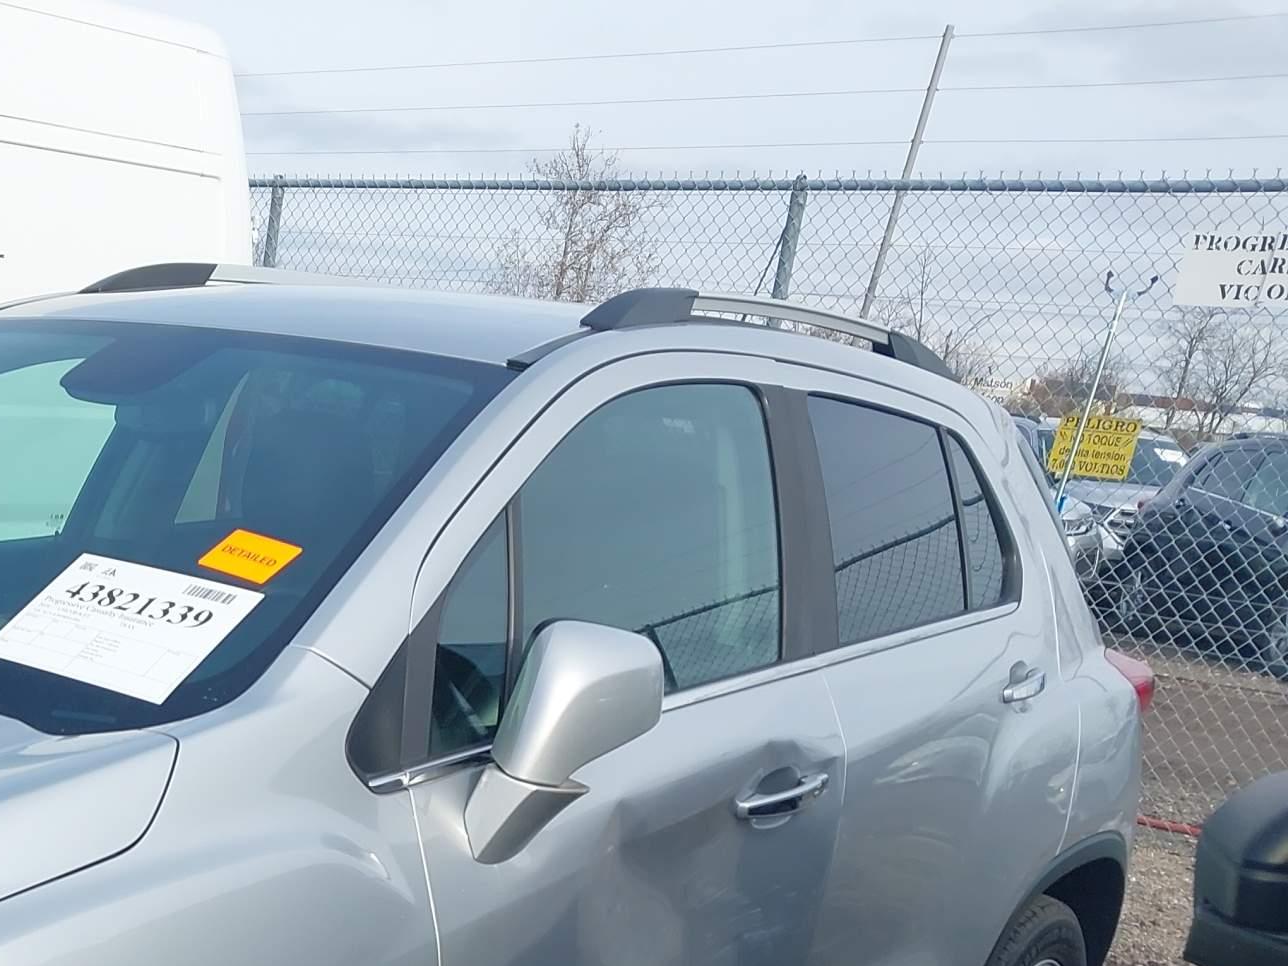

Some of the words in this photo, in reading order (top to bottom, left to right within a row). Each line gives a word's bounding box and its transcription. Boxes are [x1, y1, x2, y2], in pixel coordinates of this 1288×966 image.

[1236, 257, 1288, 275] CAR
[1219, 283, 1261, 301] VIC
[1266, 283, 1288, 301] O
[1088, 433, 1122, 448] TOQUE
[1052, 458, 1076, 471] 7,00
[1078, 461, 1126, 476] VOLTIOS
[221, 544, 278, 567] DETAILED
[65, 581, 214, 628] 43821339
